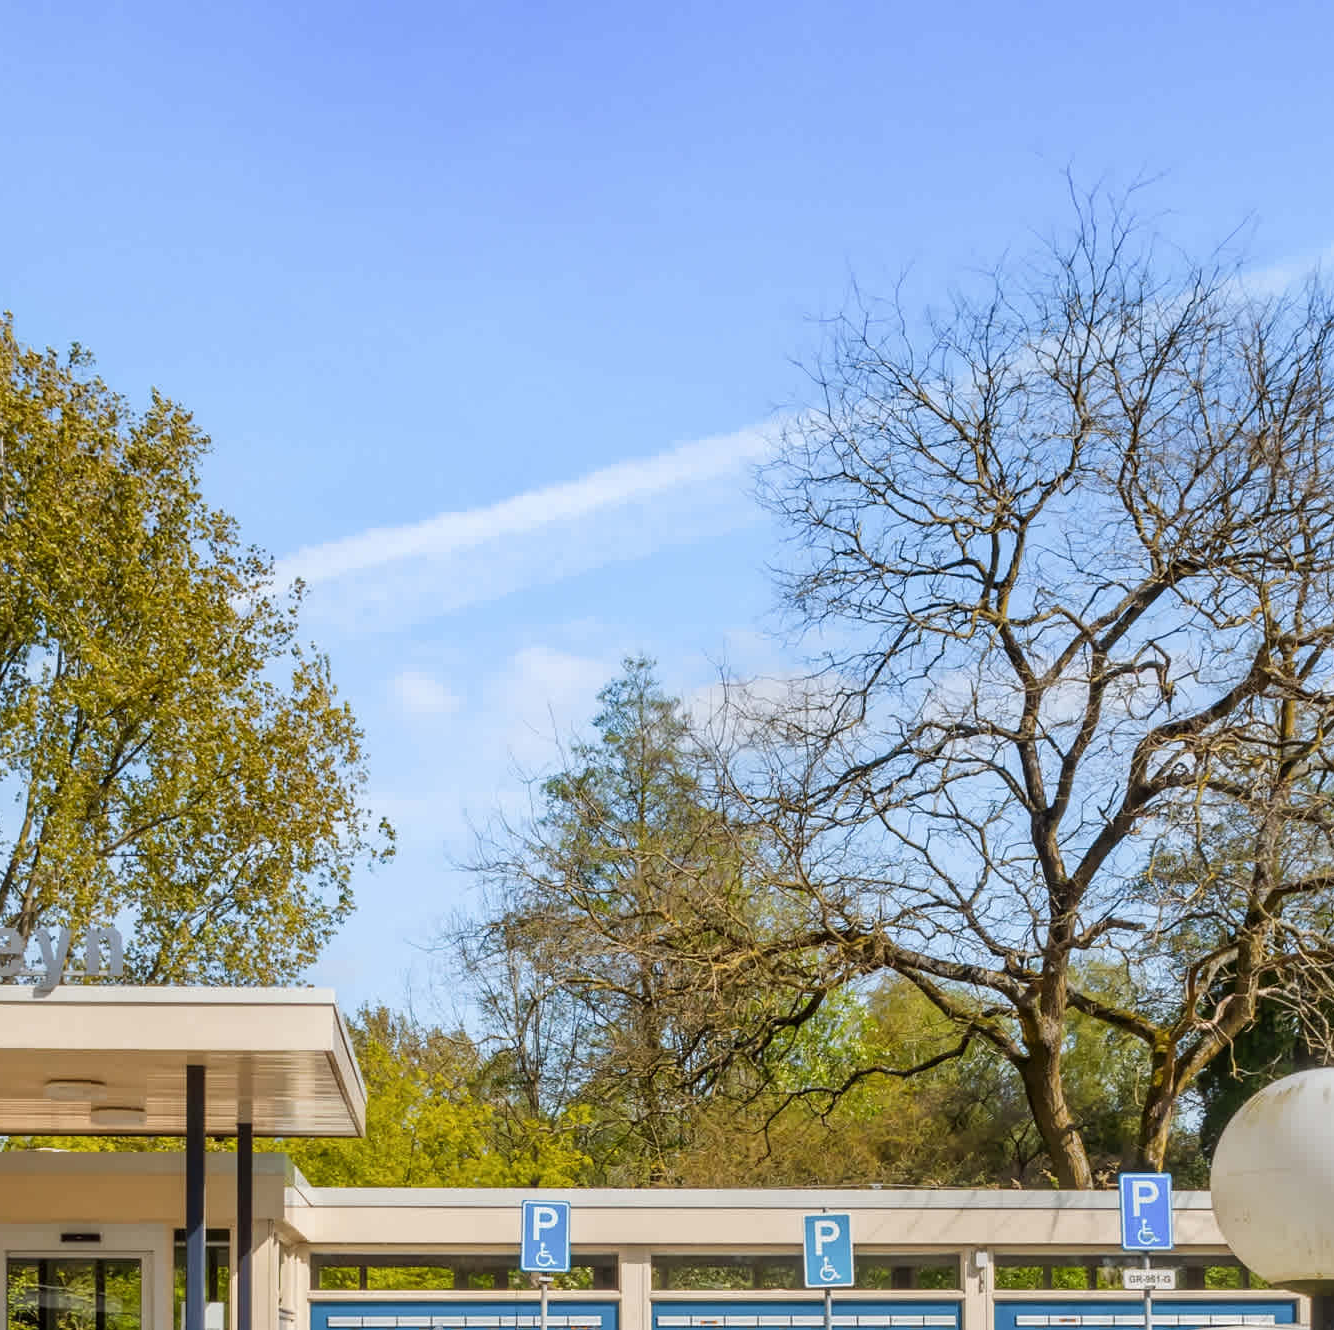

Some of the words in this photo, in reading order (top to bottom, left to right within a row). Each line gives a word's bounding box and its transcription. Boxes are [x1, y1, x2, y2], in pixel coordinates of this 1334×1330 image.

[1131, 1180, 1159, 1217] P
[532, 1206, 559, 1241] P
[815, 1219, 841, 1256] P
